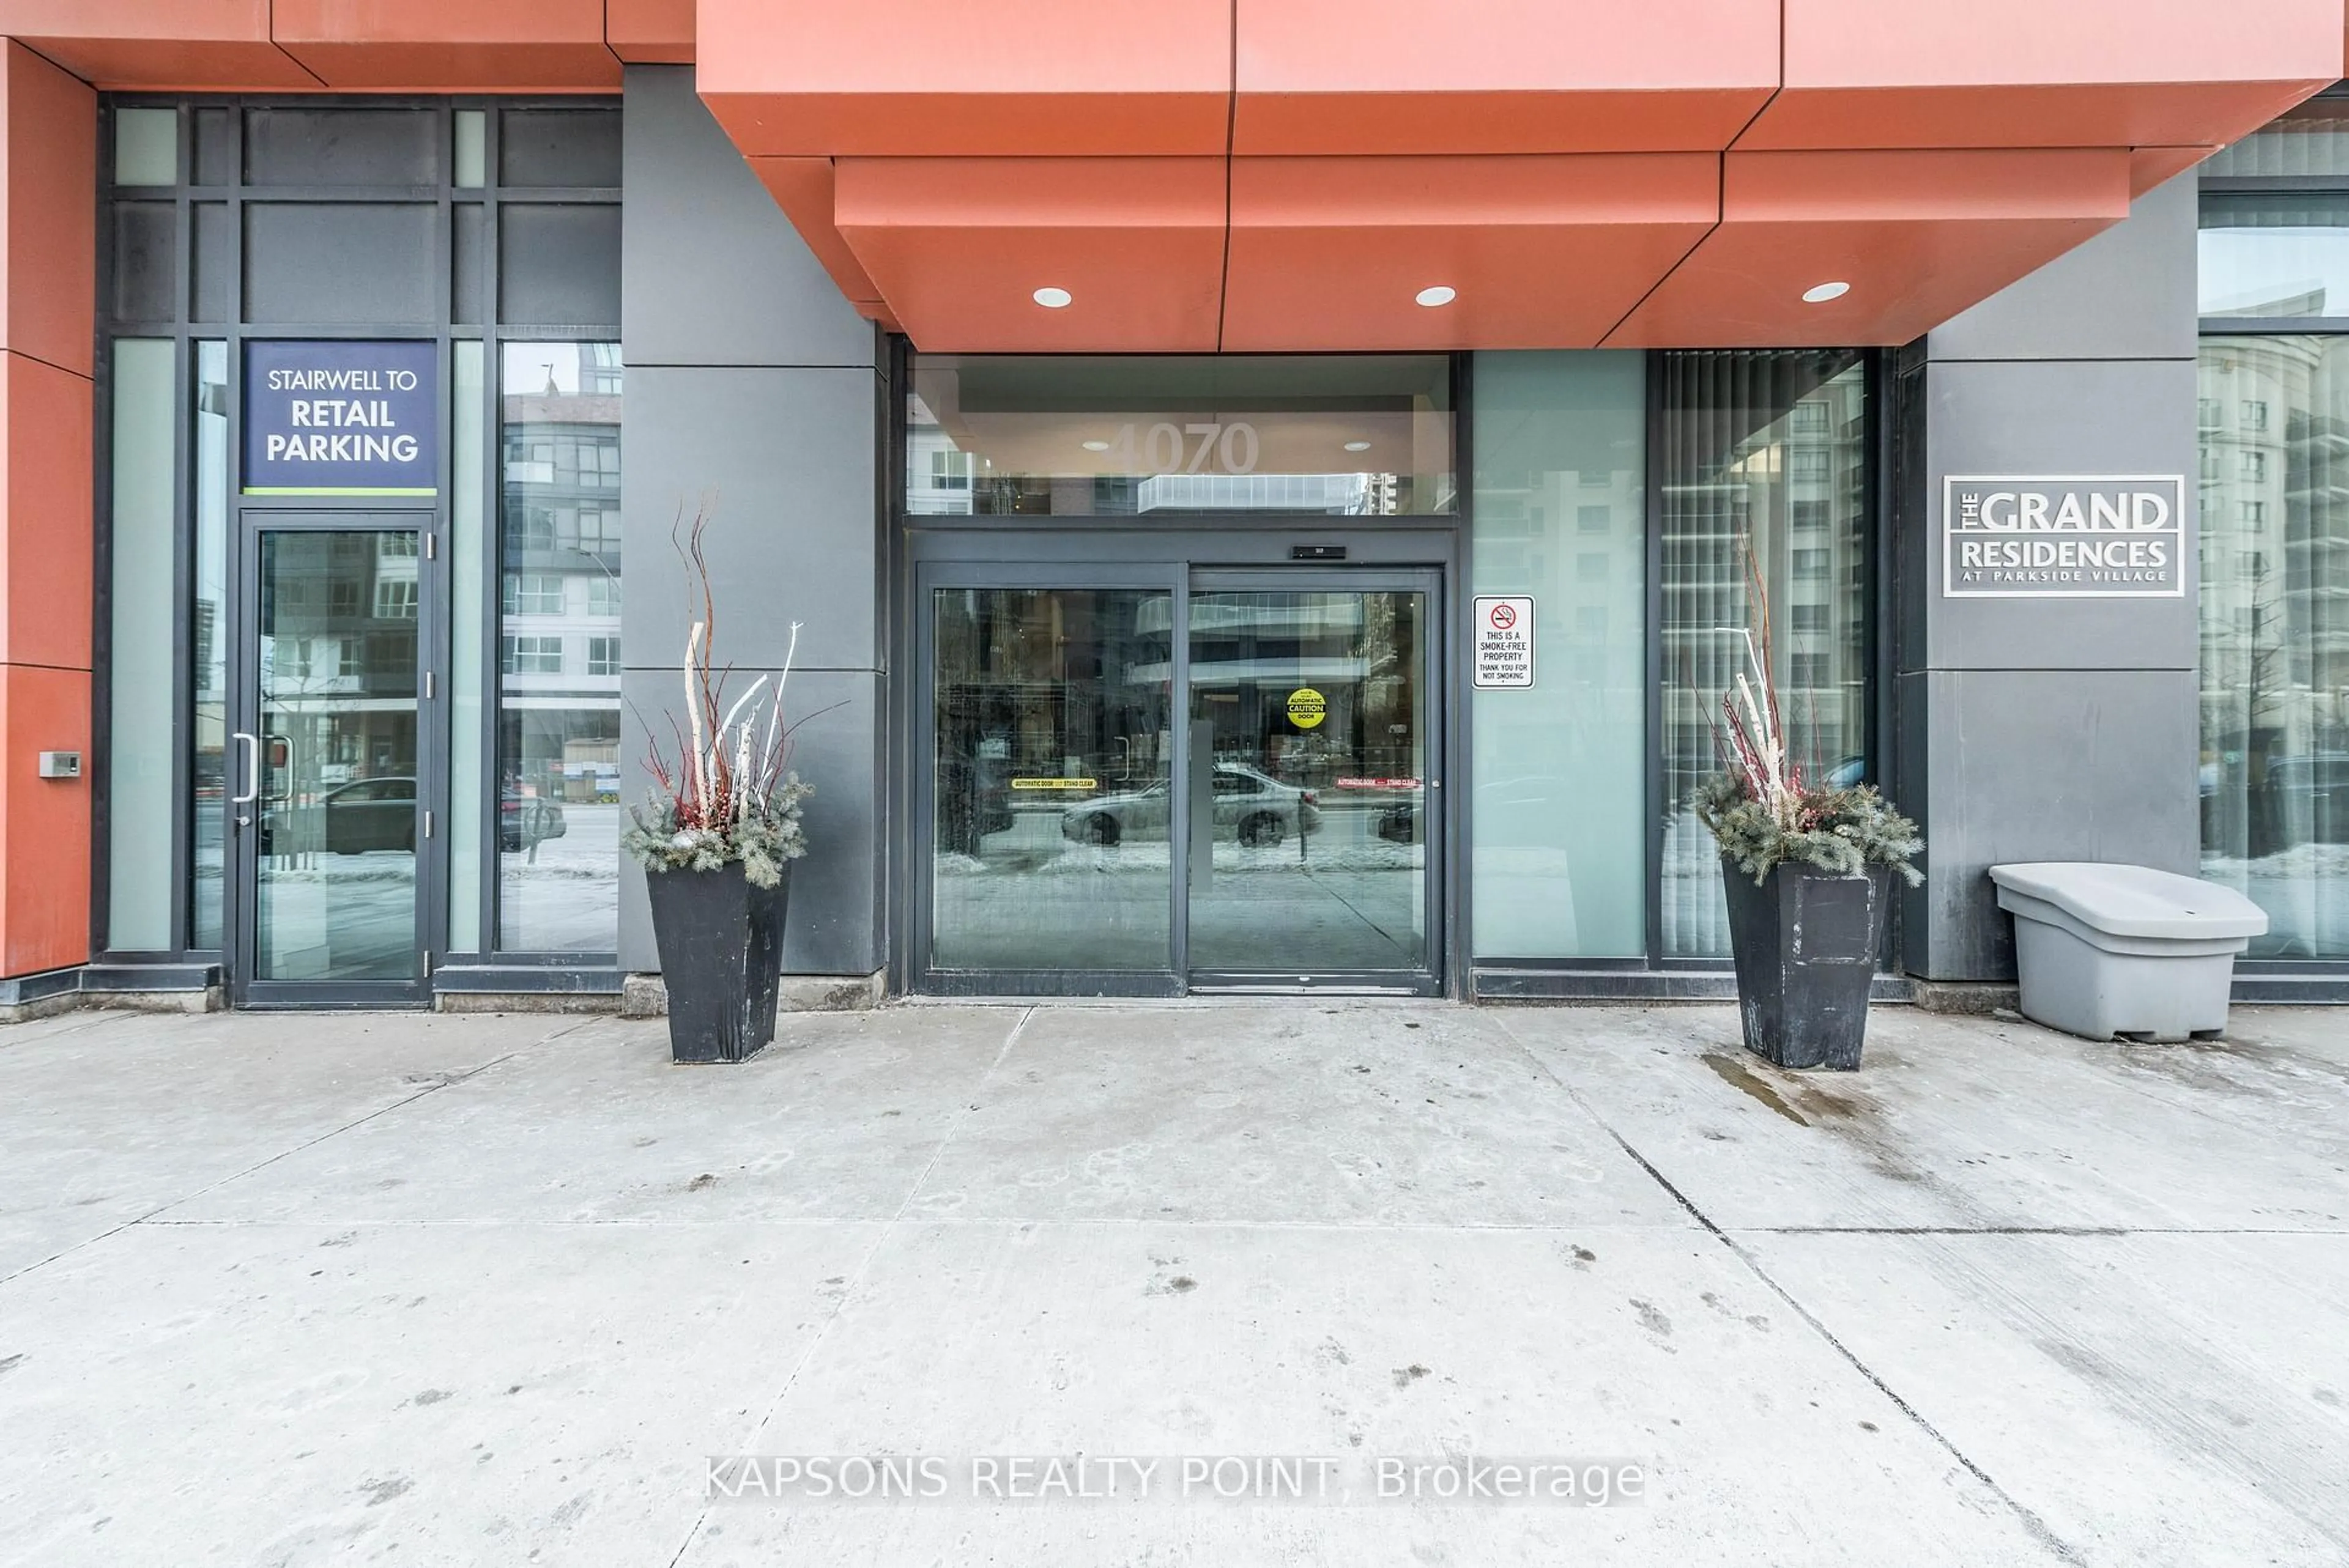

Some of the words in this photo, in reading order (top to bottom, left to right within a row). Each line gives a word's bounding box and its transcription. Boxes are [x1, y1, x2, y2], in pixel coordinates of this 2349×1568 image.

[268, 369, 382, 390] STAIRWELL
[386, 369, 417, 390] TO
[292, 399, 396, 427] RETAIL
[267, 434, 419, 462] PARKING
[1102, 422, 1259, 475] 4070
[1961, 493, 1978, 530] THE
[1980, 492, 2169, 530] GRAND
[1961, 541, 2167, 568] RESIDENCES
[1962, 571, 1981, 581] AT
[1994, 571, 2082, 581] PARKSIDE
[2091, 571, 2167, 581] VILLAGE
[1486, 632, 1503, 640] THIS
[1505, 632, 1513, 640] IS
[1515, 632, 1520, 640] A
[1483, 652, 1523, 661] PROPERTY
